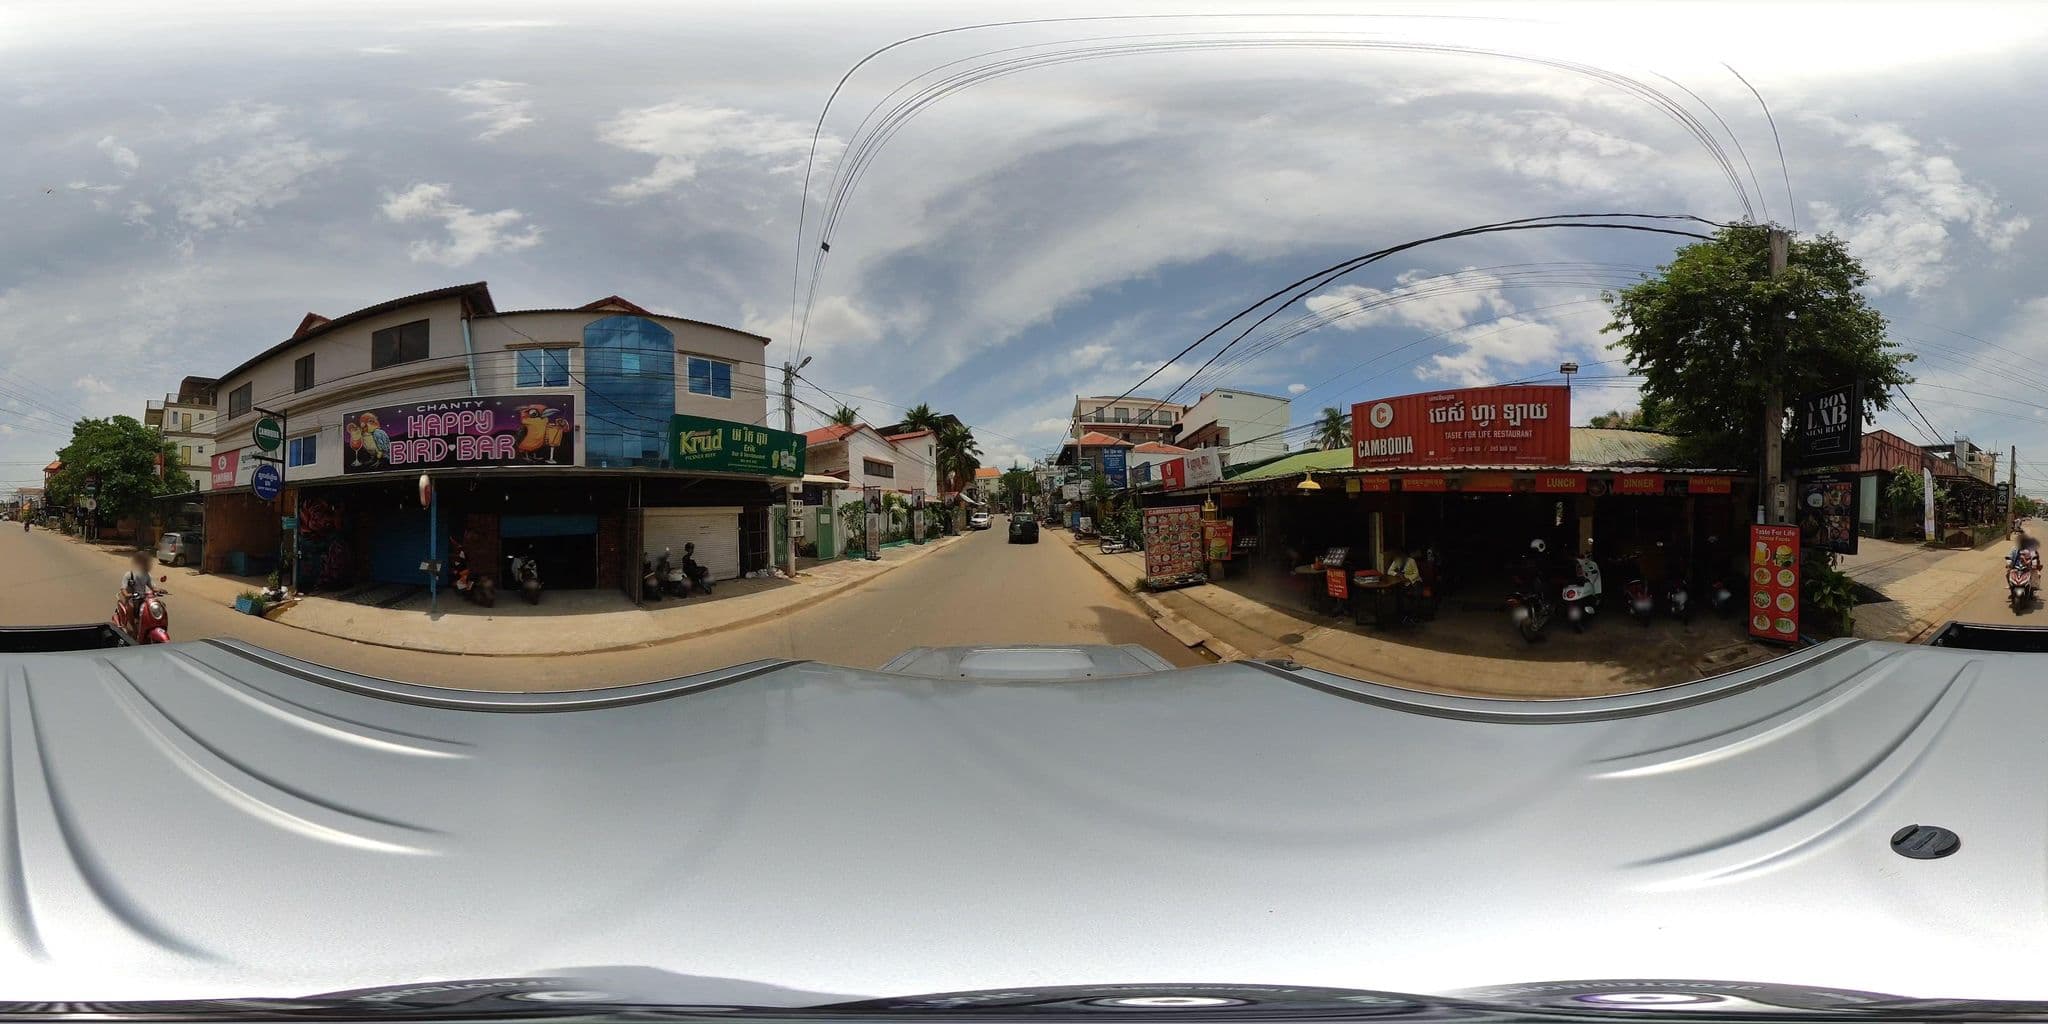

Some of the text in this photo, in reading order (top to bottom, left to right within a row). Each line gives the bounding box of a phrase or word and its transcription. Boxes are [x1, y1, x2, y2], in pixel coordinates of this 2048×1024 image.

[417, 401, 485, 412] CHANTY
[1807, 405, 1847, 430] LAB
[407, 410, 494, 438] HAPPY
[1445, 430, 1533, 440] TASTE FOR LIFE RESTAURANT
[390, 435, 515, 464] BIRD BAR
[680, 429, 723, 455] Krud
[1358, 436, 1414, 458] CAMBODIA
[1546, 477, 1575, 488] LUNCH
[1623, 478, 1654, 488] DINNER
